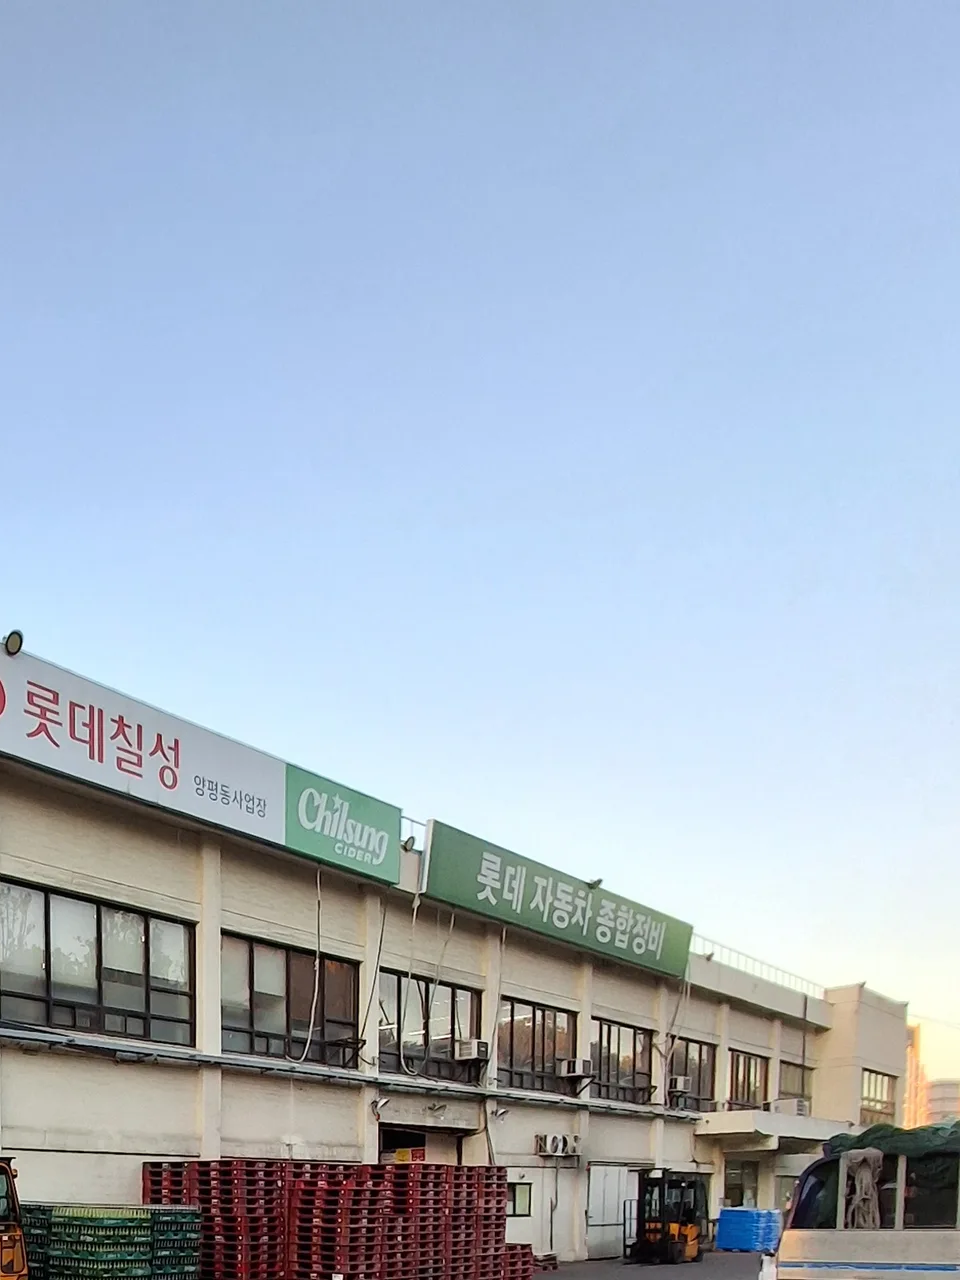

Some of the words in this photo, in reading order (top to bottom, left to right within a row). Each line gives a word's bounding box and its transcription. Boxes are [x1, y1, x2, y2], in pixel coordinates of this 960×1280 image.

[23, 679, 181, 791] 롯데칠성
[193, 774, 267, 818] 양평동사업장
[298, 787, 389, 866] Chilsung
[334, 842, 373, 865] CIDER
[476, 851, 527, 915] 롯데
[529, 875, 593, 937] 자동차
[595, 898, 667, 961] 종합정비
